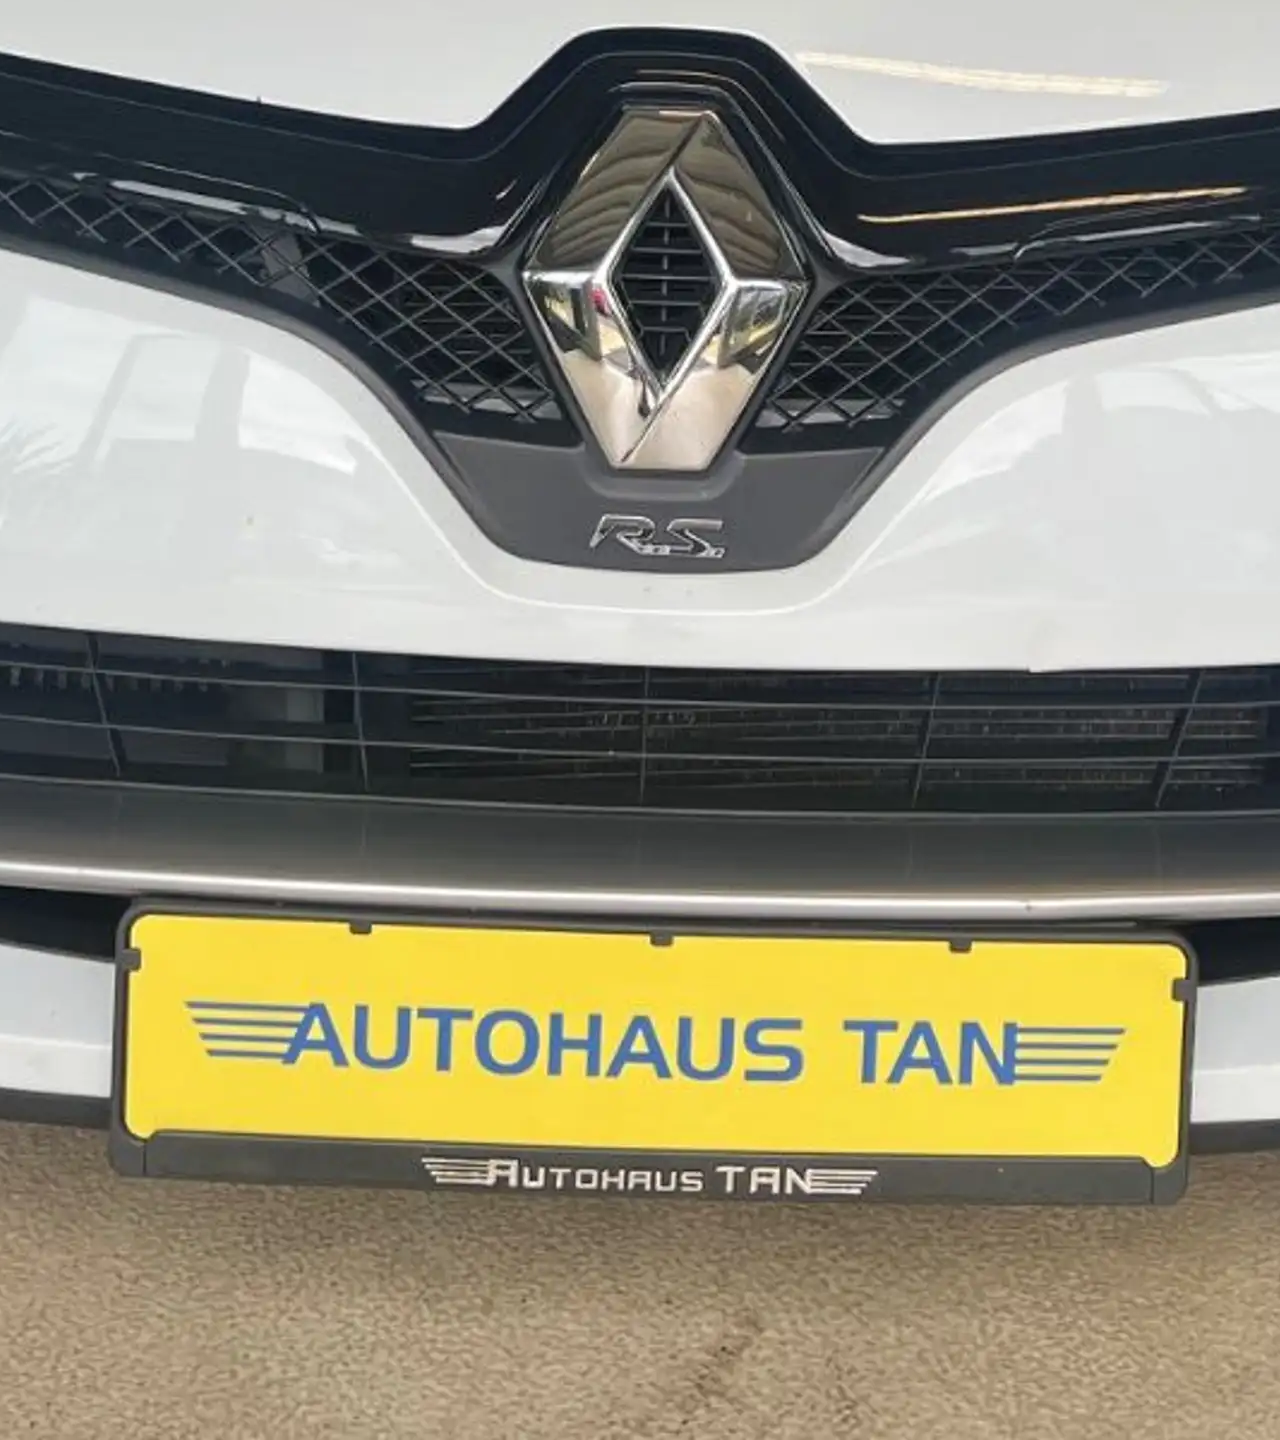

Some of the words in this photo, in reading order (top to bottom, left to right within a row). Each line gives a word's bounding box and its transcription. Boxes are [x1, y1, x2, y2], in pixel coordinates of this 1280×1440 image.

[278, 1003, 803, 1083] AUTOHAUS
[843, 1019, 1021, 1086] TAN
[716, 1165, 811, 1195] TAN
